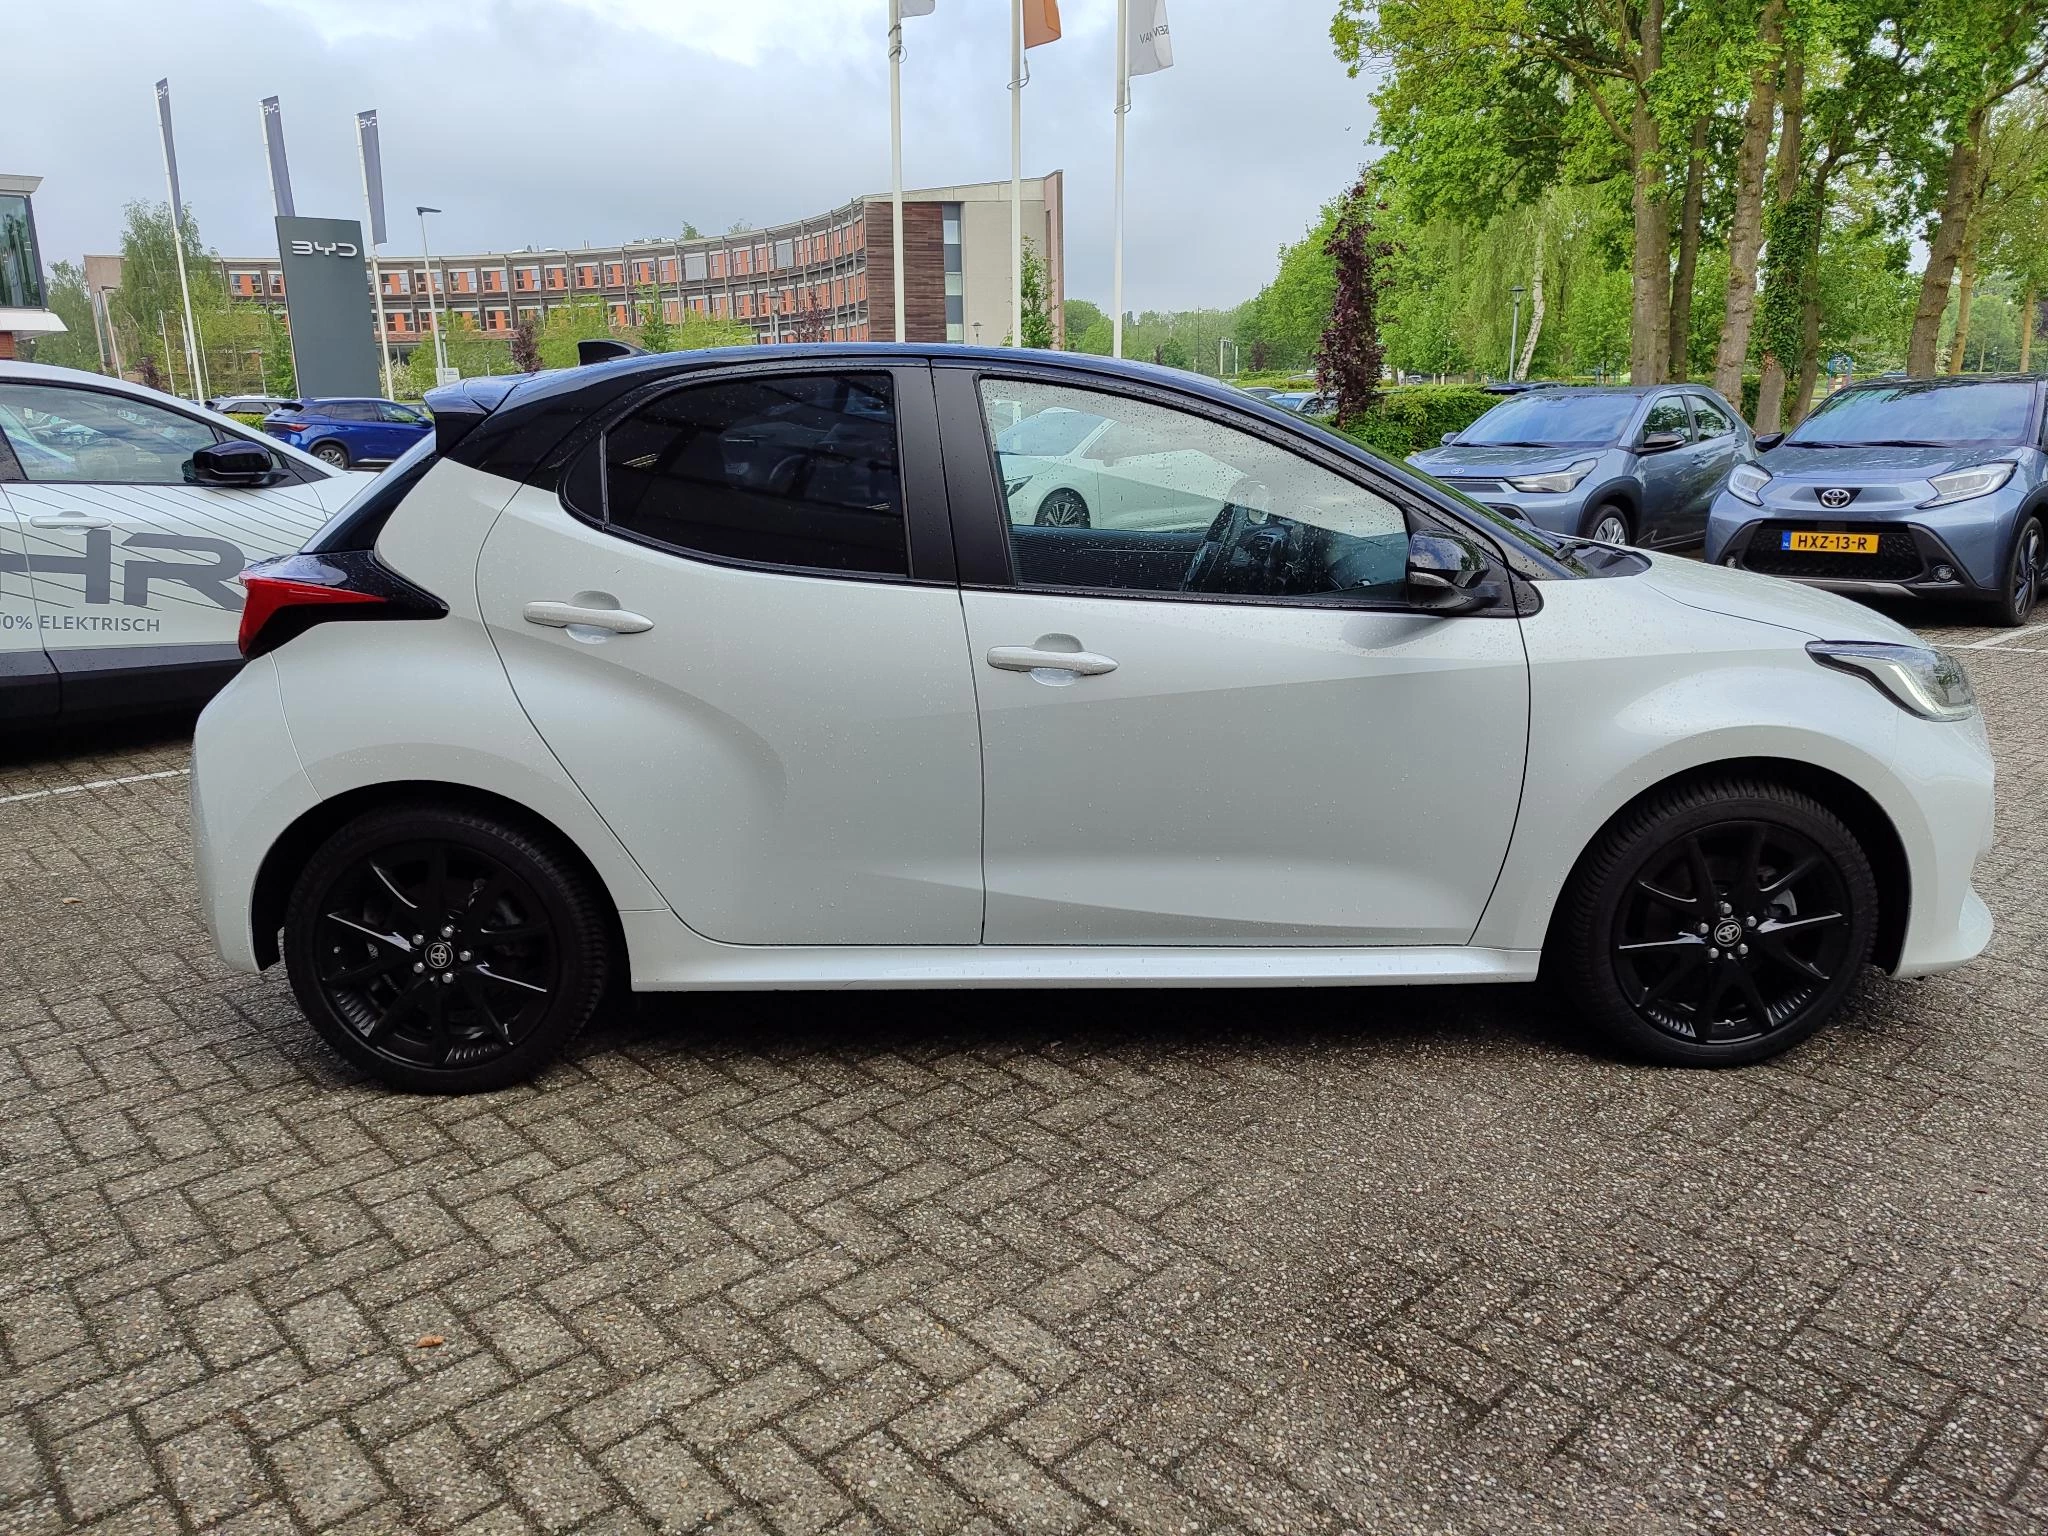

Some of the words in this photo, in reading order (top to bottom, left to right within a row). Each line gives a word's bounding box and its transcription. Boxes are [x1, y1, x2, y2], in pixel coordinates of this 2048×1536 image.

[264, 104, 280, 115] BYD
[359, 116, 377, 129] BYD
[291, 240, 358, 257] BYD
[1797, 534, 1868, 551] HXZ-13-R
[0, 615, 33, 630] 0%
[40, 615, 161, 632] ELEKTRISCH
